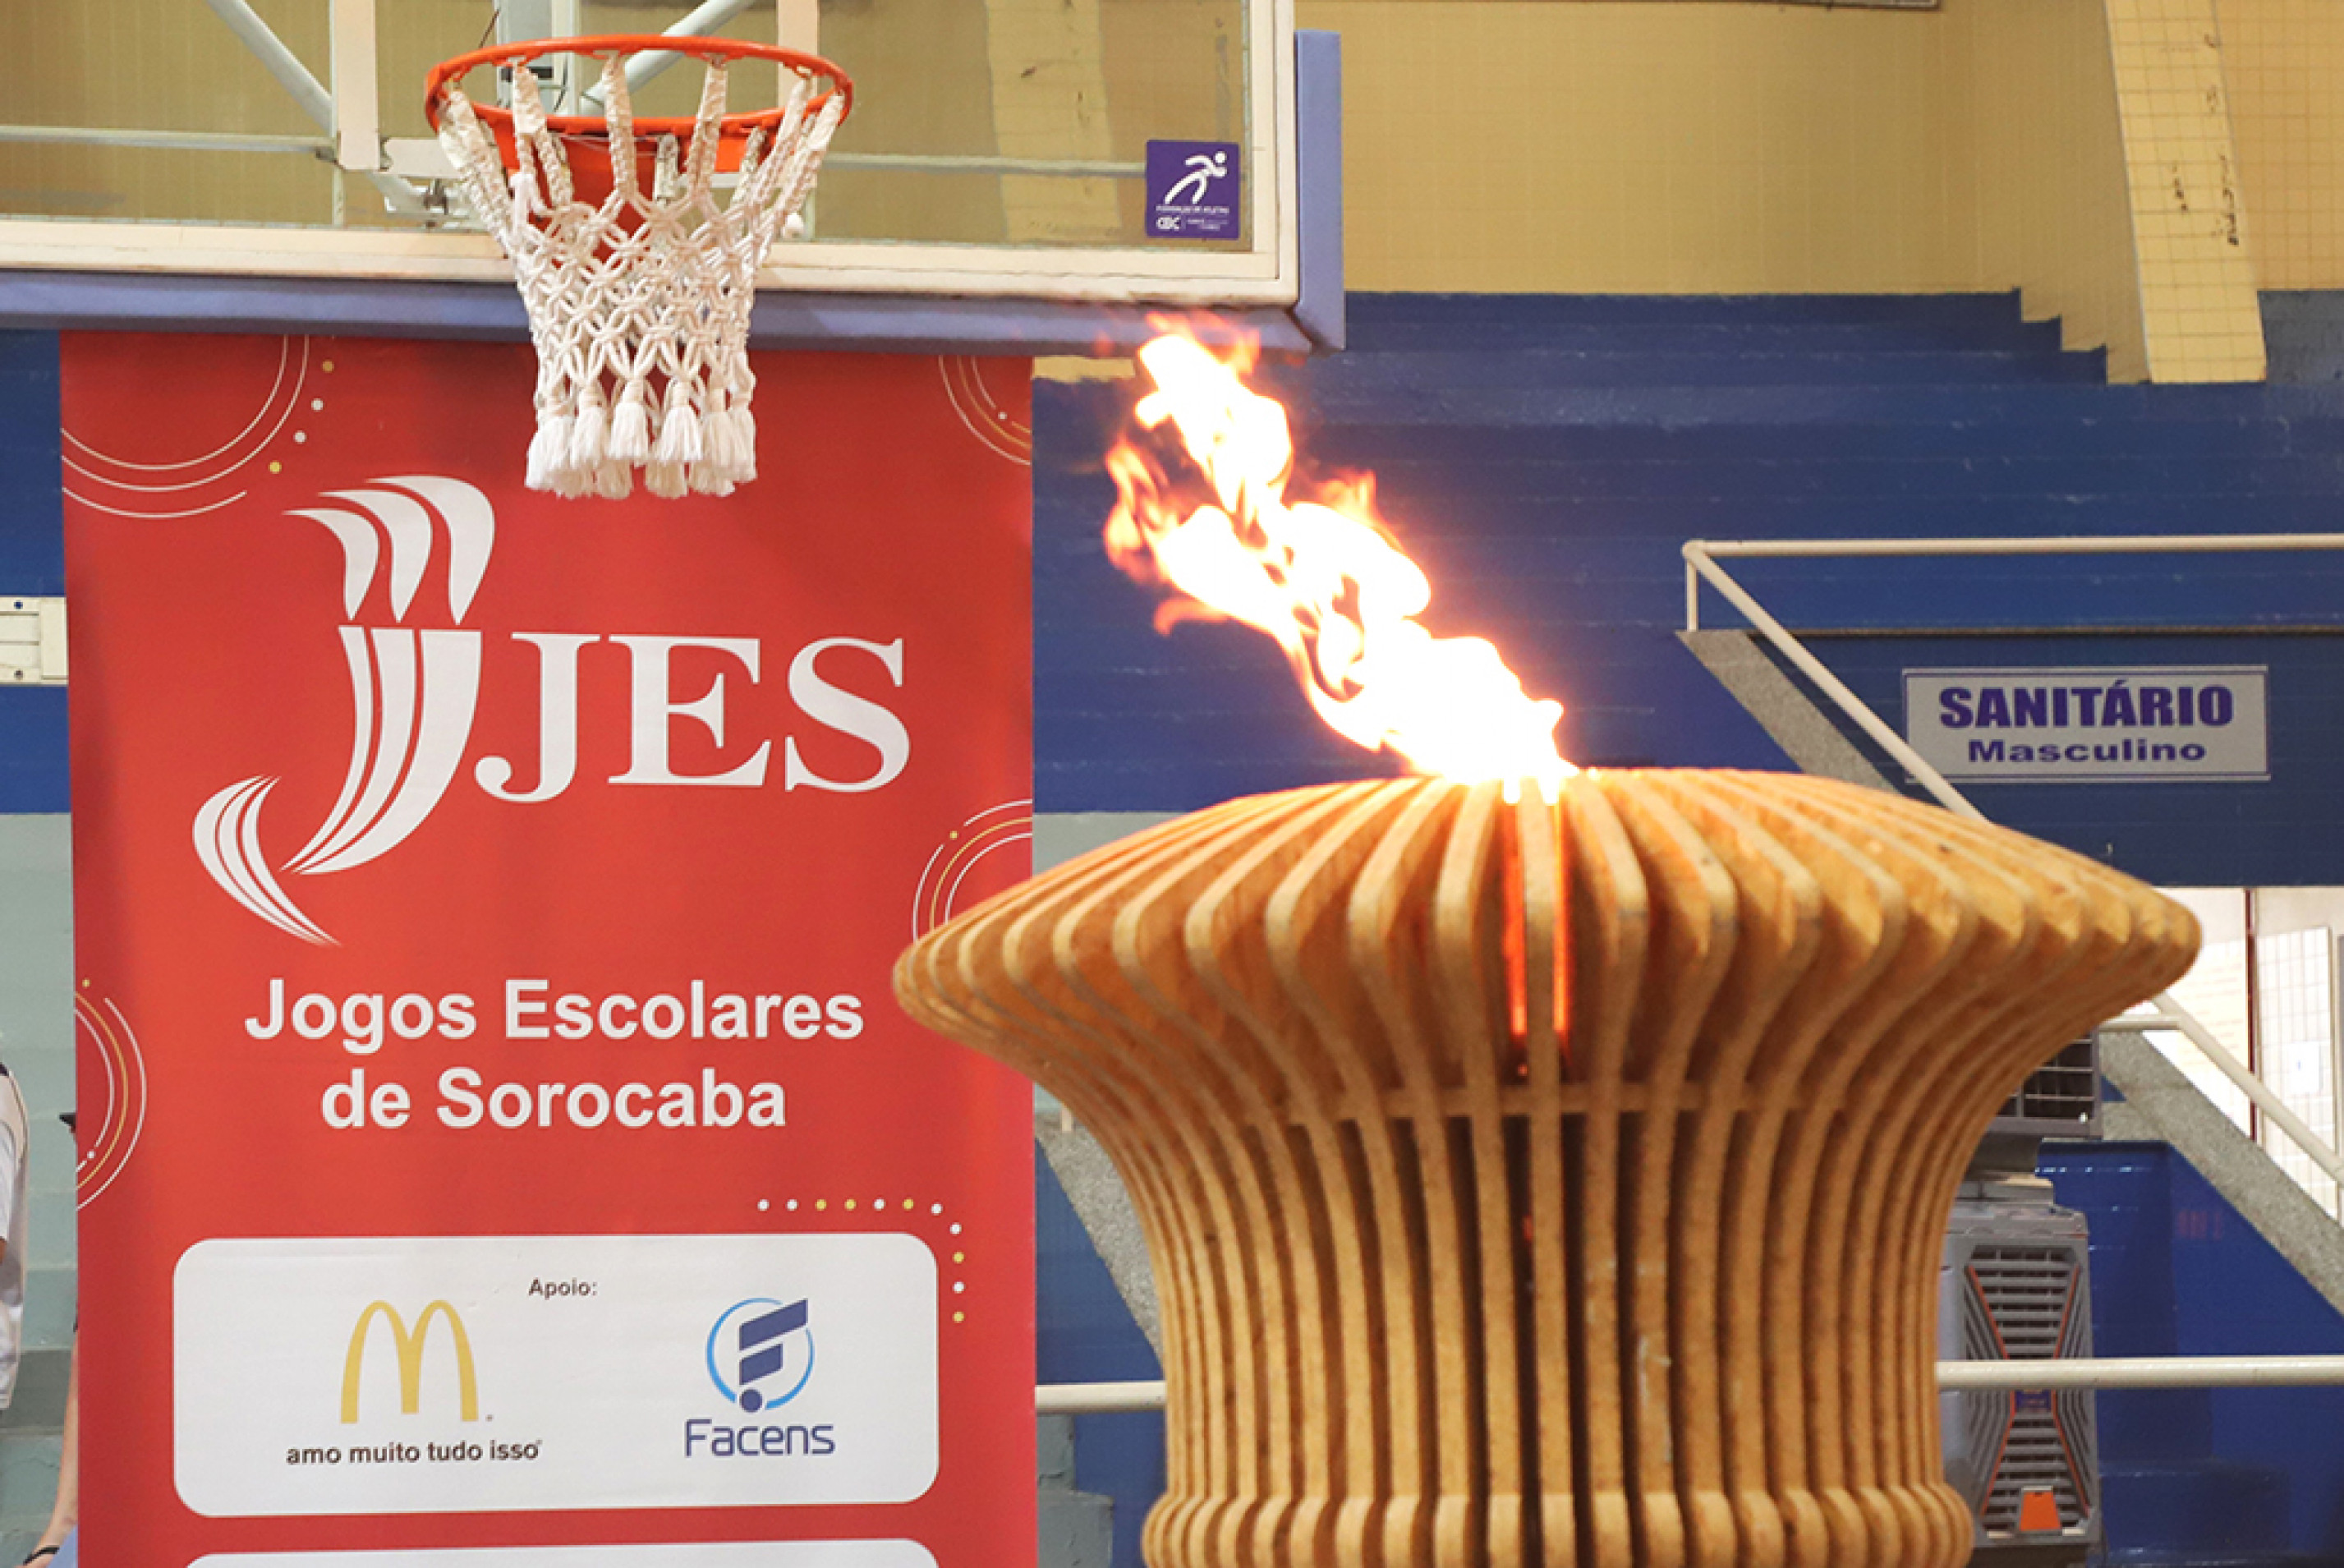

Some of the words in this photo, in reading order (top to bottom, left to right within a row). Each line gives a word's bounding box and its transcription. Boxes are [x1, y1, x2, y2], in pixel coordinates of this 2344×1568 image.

[474, 632, 910, 802] JES
[1938, 679, 2234, 729] SANITÁRIO
[1967, 738, 2207, 763] Masculino
[245, 978, 478, 1055] Jogos
[504, 978, 865, 1041] Escolares
[321, 1068, 411, 1129] de
[435, 1066, 787, 1129] Sorocaba
[527, 1278, 597, 1300] Apoio:
[285, 1446, 342, 1465] amo
[348, 1442, 421, 1464] muito
[426, 1440, 484, 1462] tudo
[489, 1439, 540, 1461] isso
[684, 1418, 837, 1458] Facens
